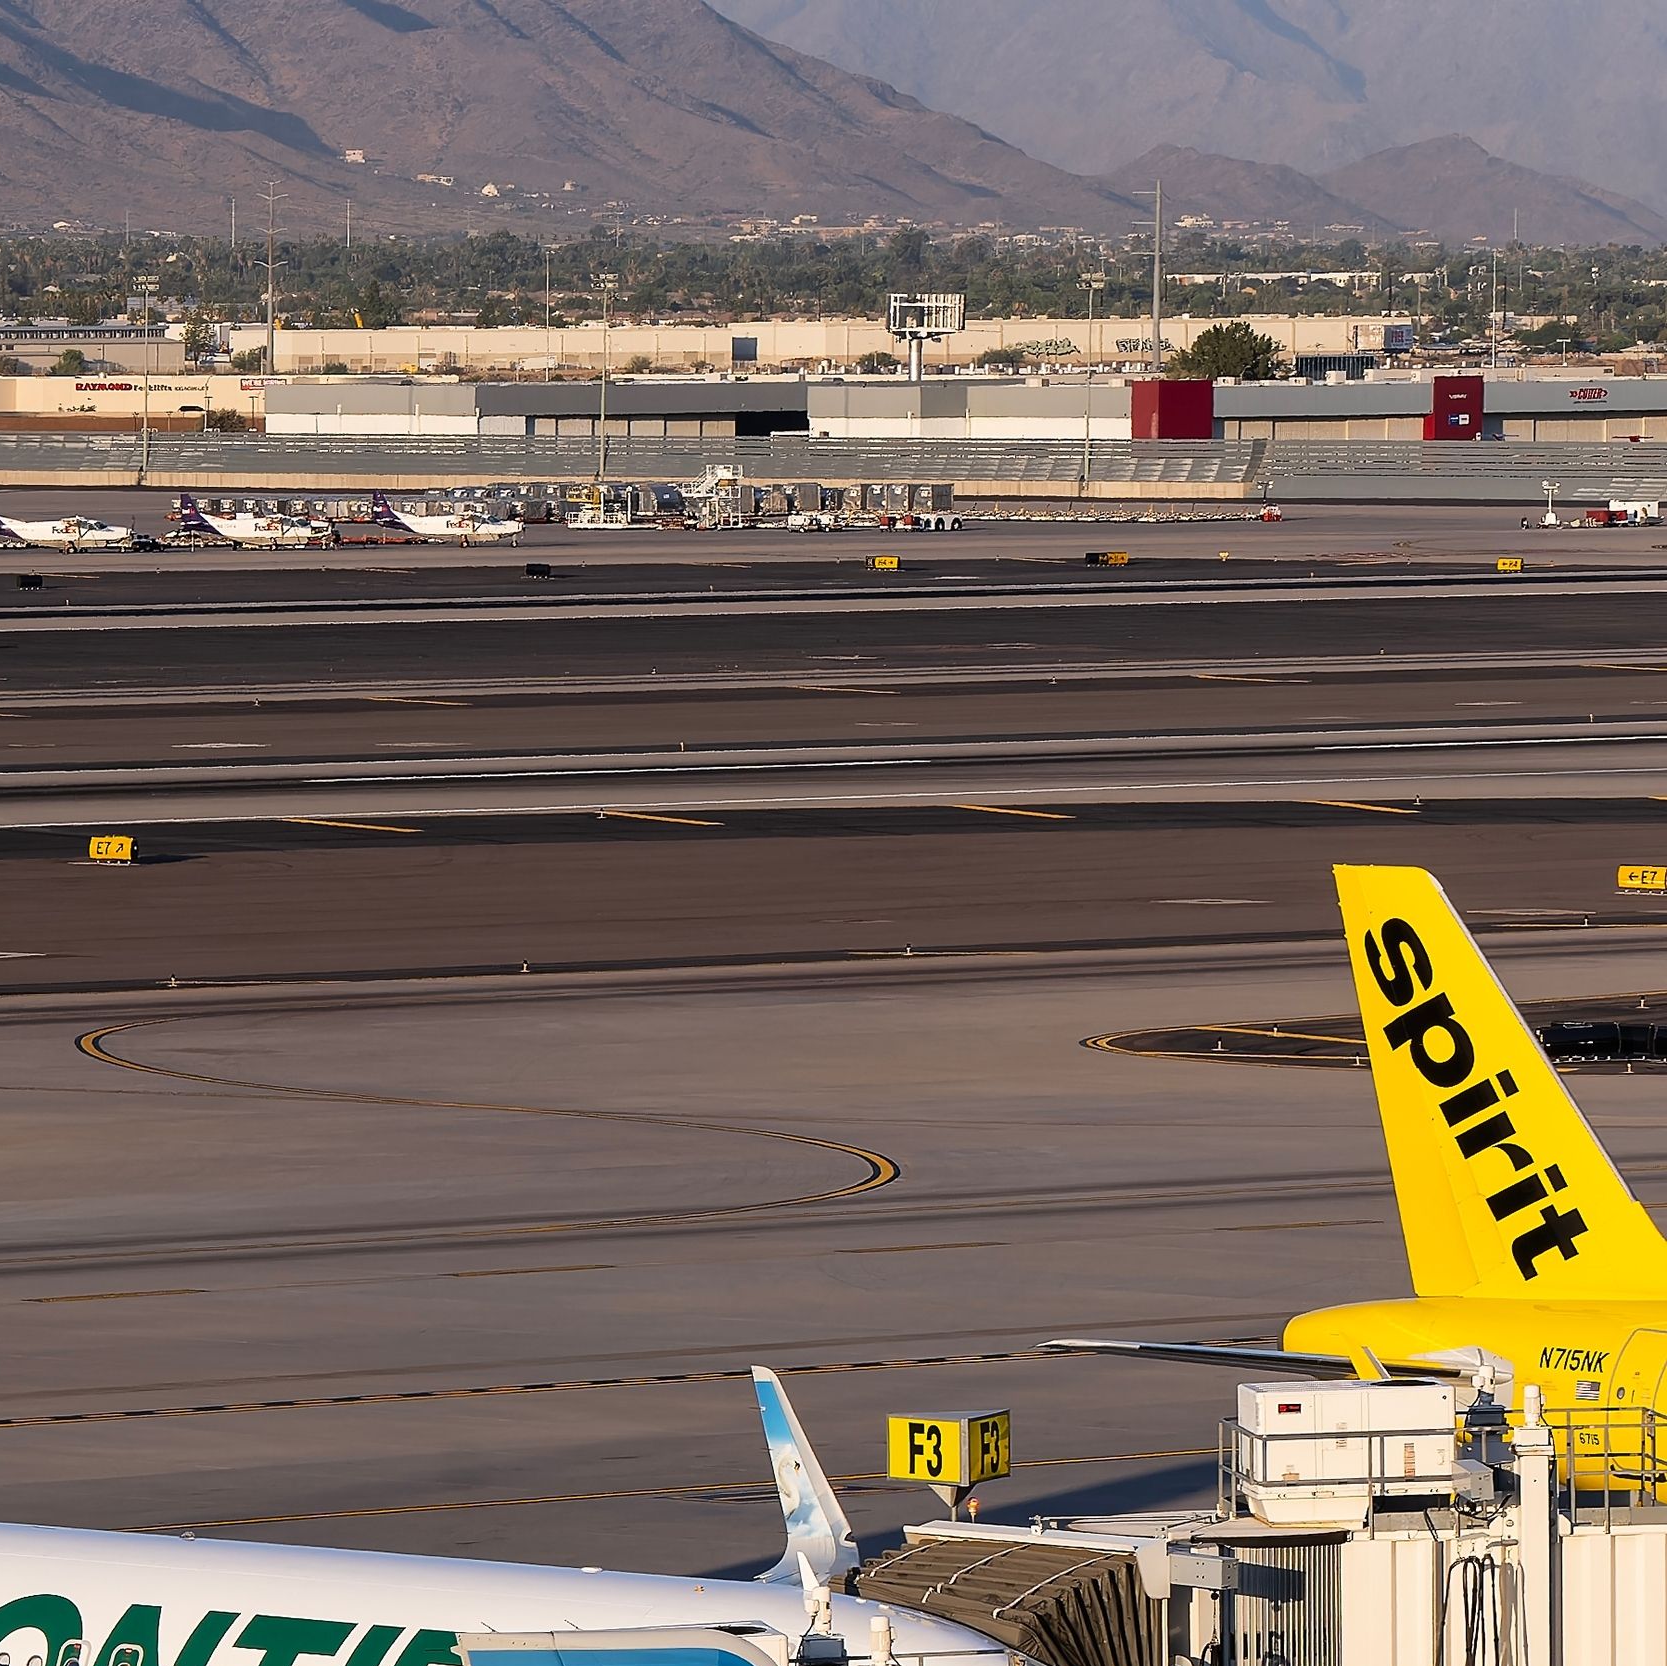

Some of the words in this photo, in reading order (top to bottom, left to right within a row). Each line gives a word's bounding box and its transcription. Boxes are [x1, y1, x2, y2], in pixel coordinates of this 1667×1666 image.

[254, 523, 280, 532] FedEx
[96, 841, 112, 855] E7
[1641, 870, 1658, 885] E7
[1364, 917, 1589, 1281] spirit
[1539, 1346, 1610, 1374] N715NK
[979, 1420, 1001, 1475] F3
[1579, 1432, 1600, 1446] 6715
[908, 1423, 942, 1478] F3
